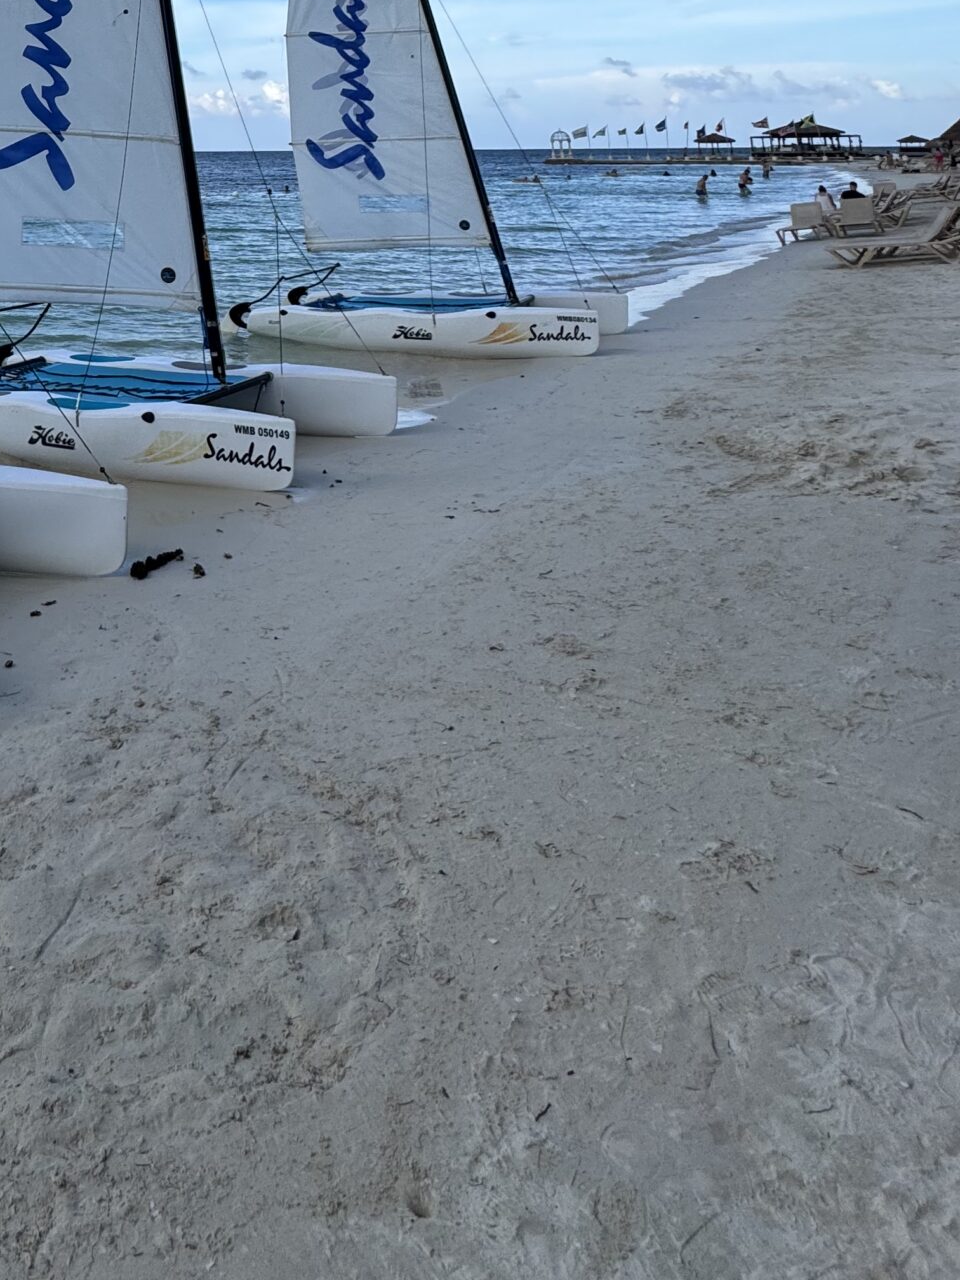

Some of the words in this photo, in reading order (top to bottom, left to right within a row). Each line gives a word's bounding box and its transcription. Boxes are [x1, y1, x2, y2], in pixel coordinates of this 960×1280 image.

[392, 325, 432, 340] Hobie
[528, 323, 591, 341] Sandals
[28, 425, 75, 450] Hobie
[234, 424, 256, 435] WMB
[258, 427, 290, 439] 050149
[203, 433, 291, 472] Sandals
